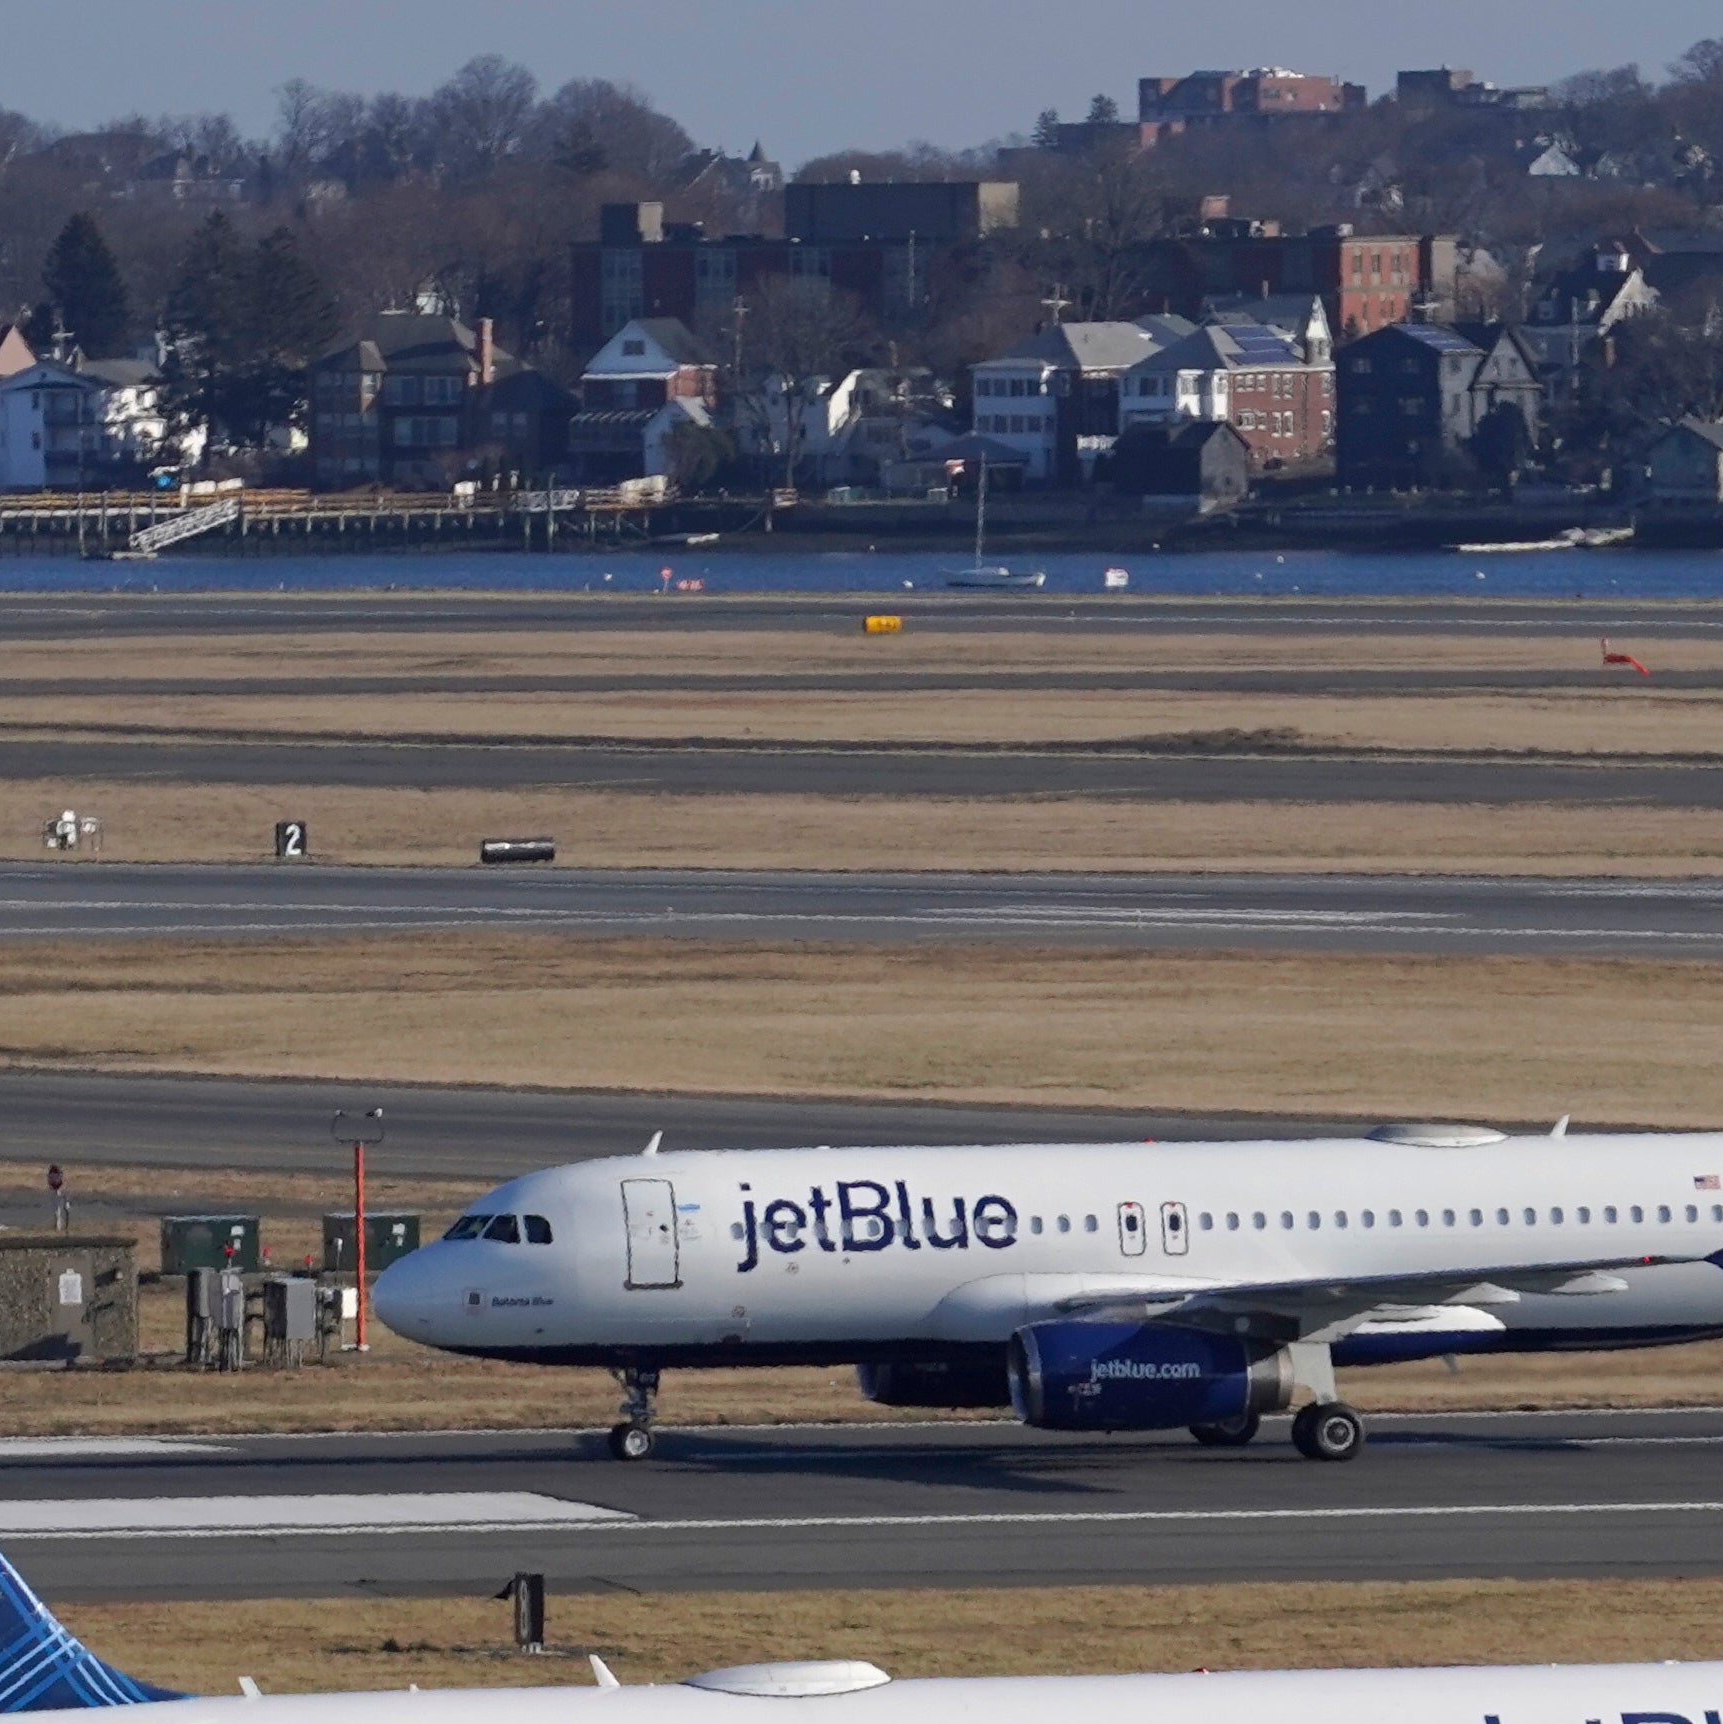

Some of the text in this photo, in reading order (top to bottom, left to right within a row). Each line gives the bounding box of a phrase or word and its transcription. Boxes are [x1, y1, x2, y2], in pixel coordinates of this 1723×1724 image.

[285, 823, 301, 856] 2
[737, 1180, 1017, 1273] jetBlue
[1090, 1358, 1202, 1383] jetblue.com
